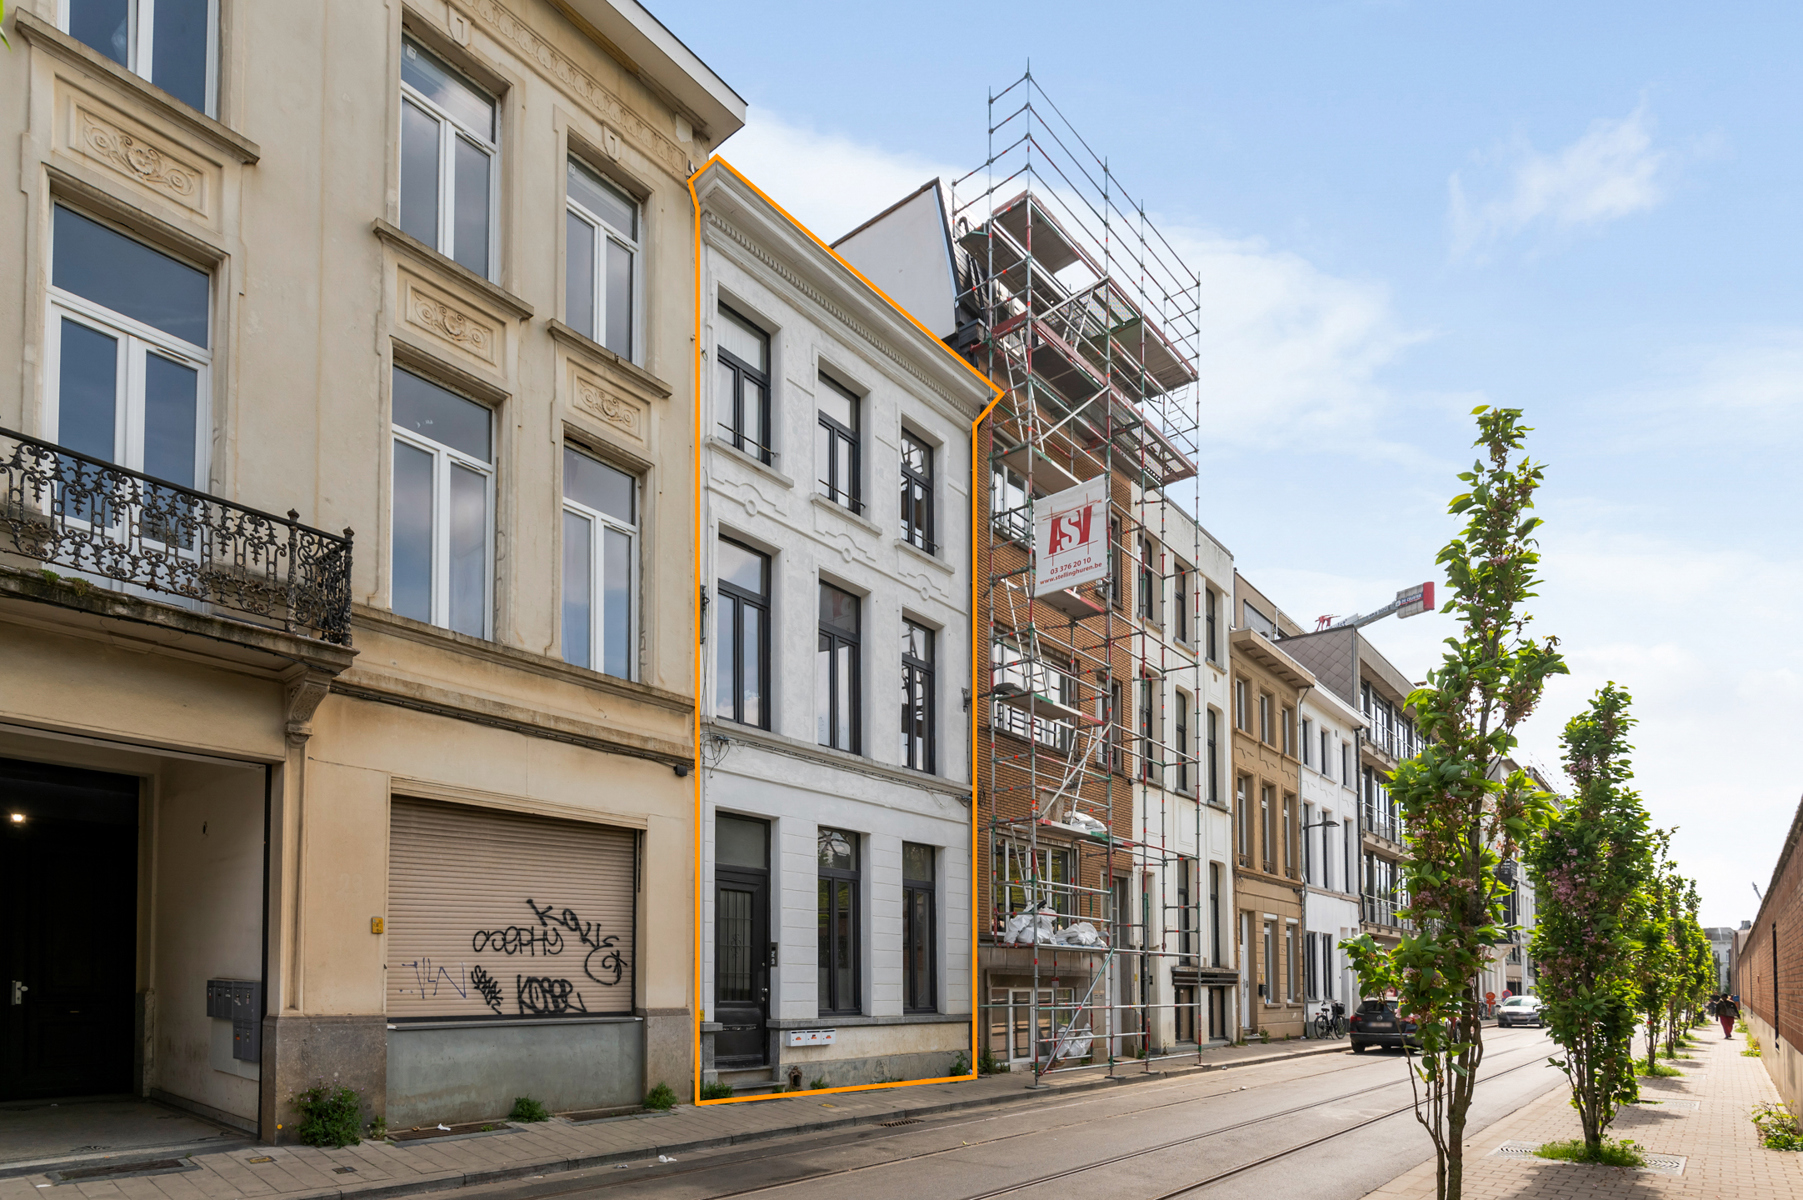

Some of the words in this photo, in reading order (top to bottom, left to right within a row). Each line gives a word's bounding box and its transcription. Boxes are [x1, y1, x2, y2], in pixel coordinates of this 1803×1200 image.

[1048, 505, 1093, 555] ASV
[1040, 562, 1102, 585] www.stellinghuren.be
[1050, 567, 1058, 575] 03
[1060, 563, 1072, 572] 376
[1073, 560, 1081, 568] 20
